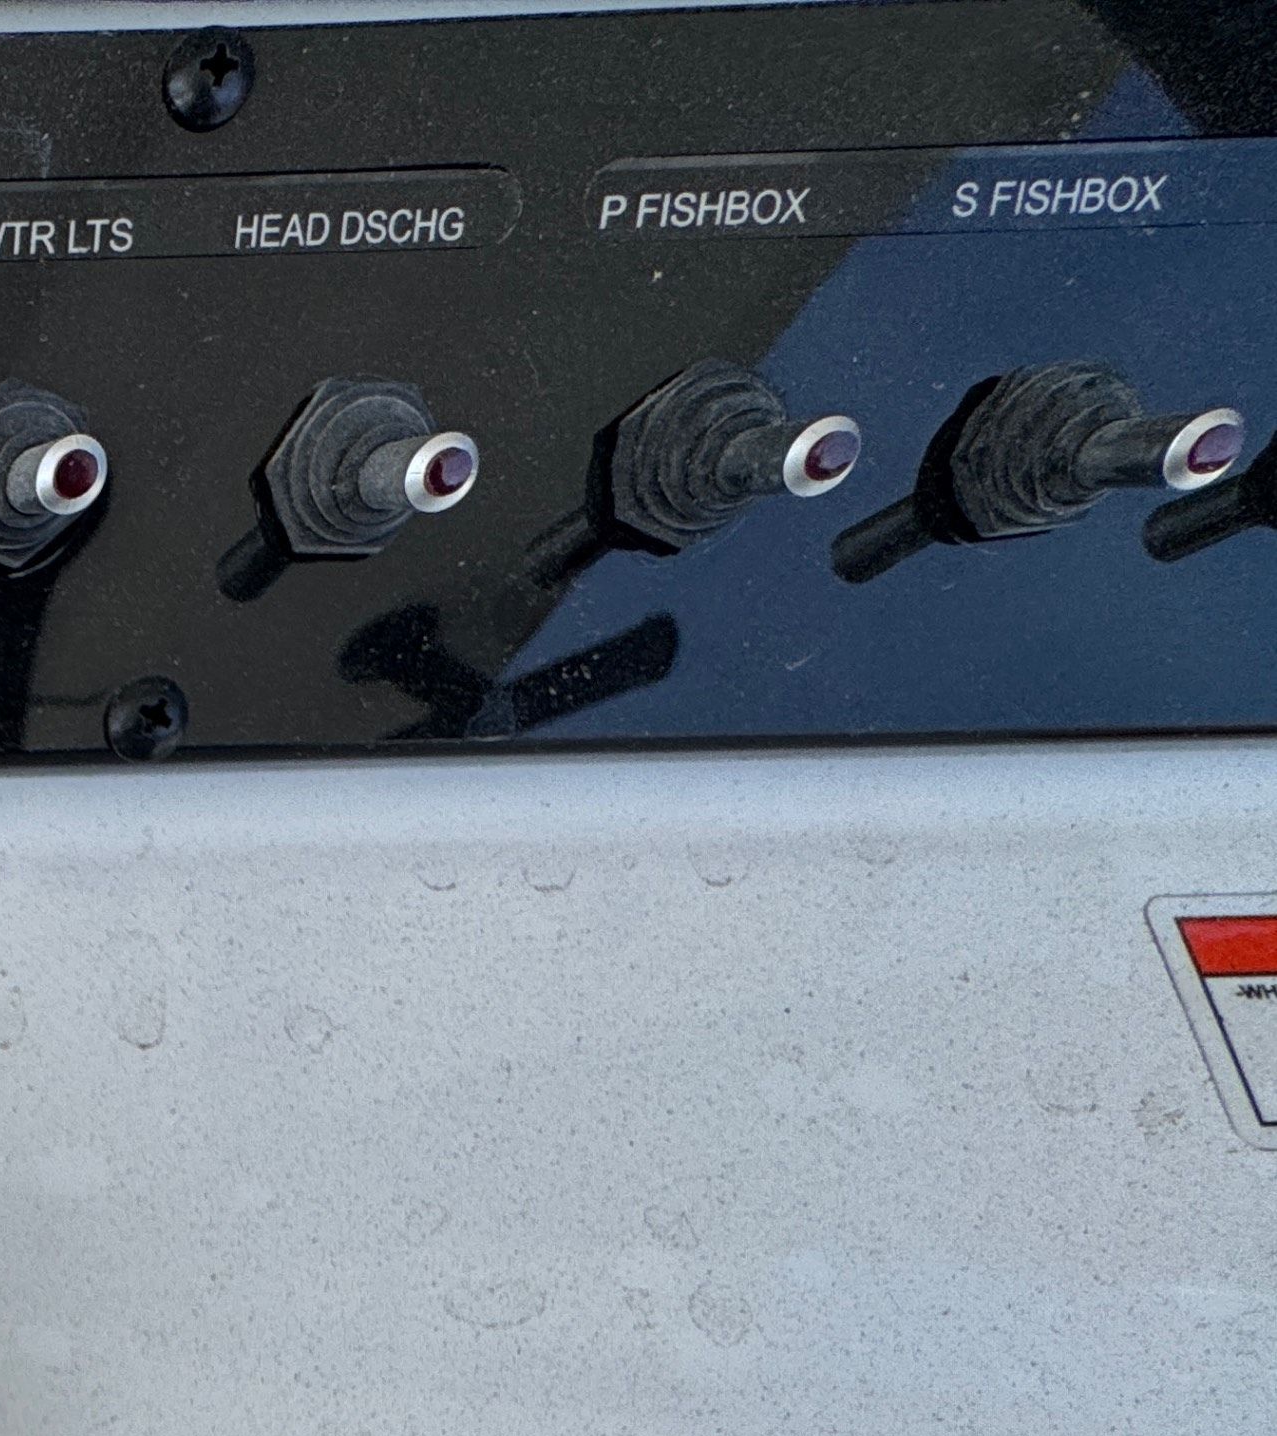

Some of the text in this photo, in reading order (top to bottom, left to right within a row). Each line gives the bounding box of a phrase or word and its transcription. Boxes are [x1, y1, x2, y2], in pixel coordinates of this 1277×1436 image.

[599, 187, 811, 230] P FISHBOX
[952, 175, 1168, 218] S FISHBOX
[68, 217, 133, 254] LTS
[234, 206, 465, 249] HEAD DSCHG
